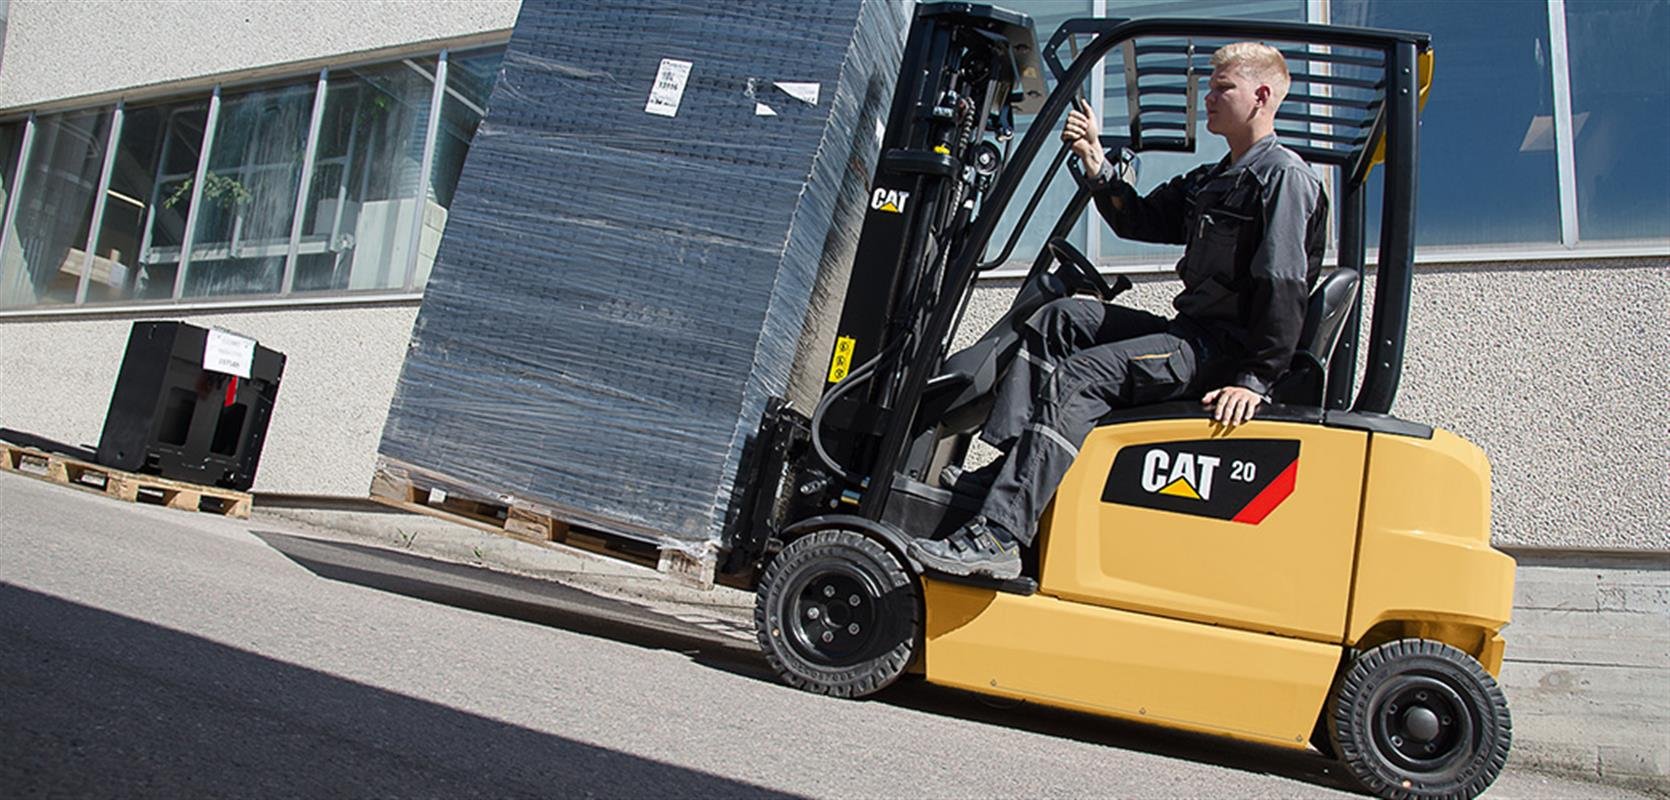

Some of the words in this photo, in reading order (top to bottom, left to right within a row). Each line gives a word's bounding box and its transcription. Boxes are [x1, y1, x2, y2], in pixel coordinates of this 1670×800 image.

[871, 187, 910, 213] CAT
[1141, 449, 1220, 500] CAT
[1230, 460, 1256, 482] 20
